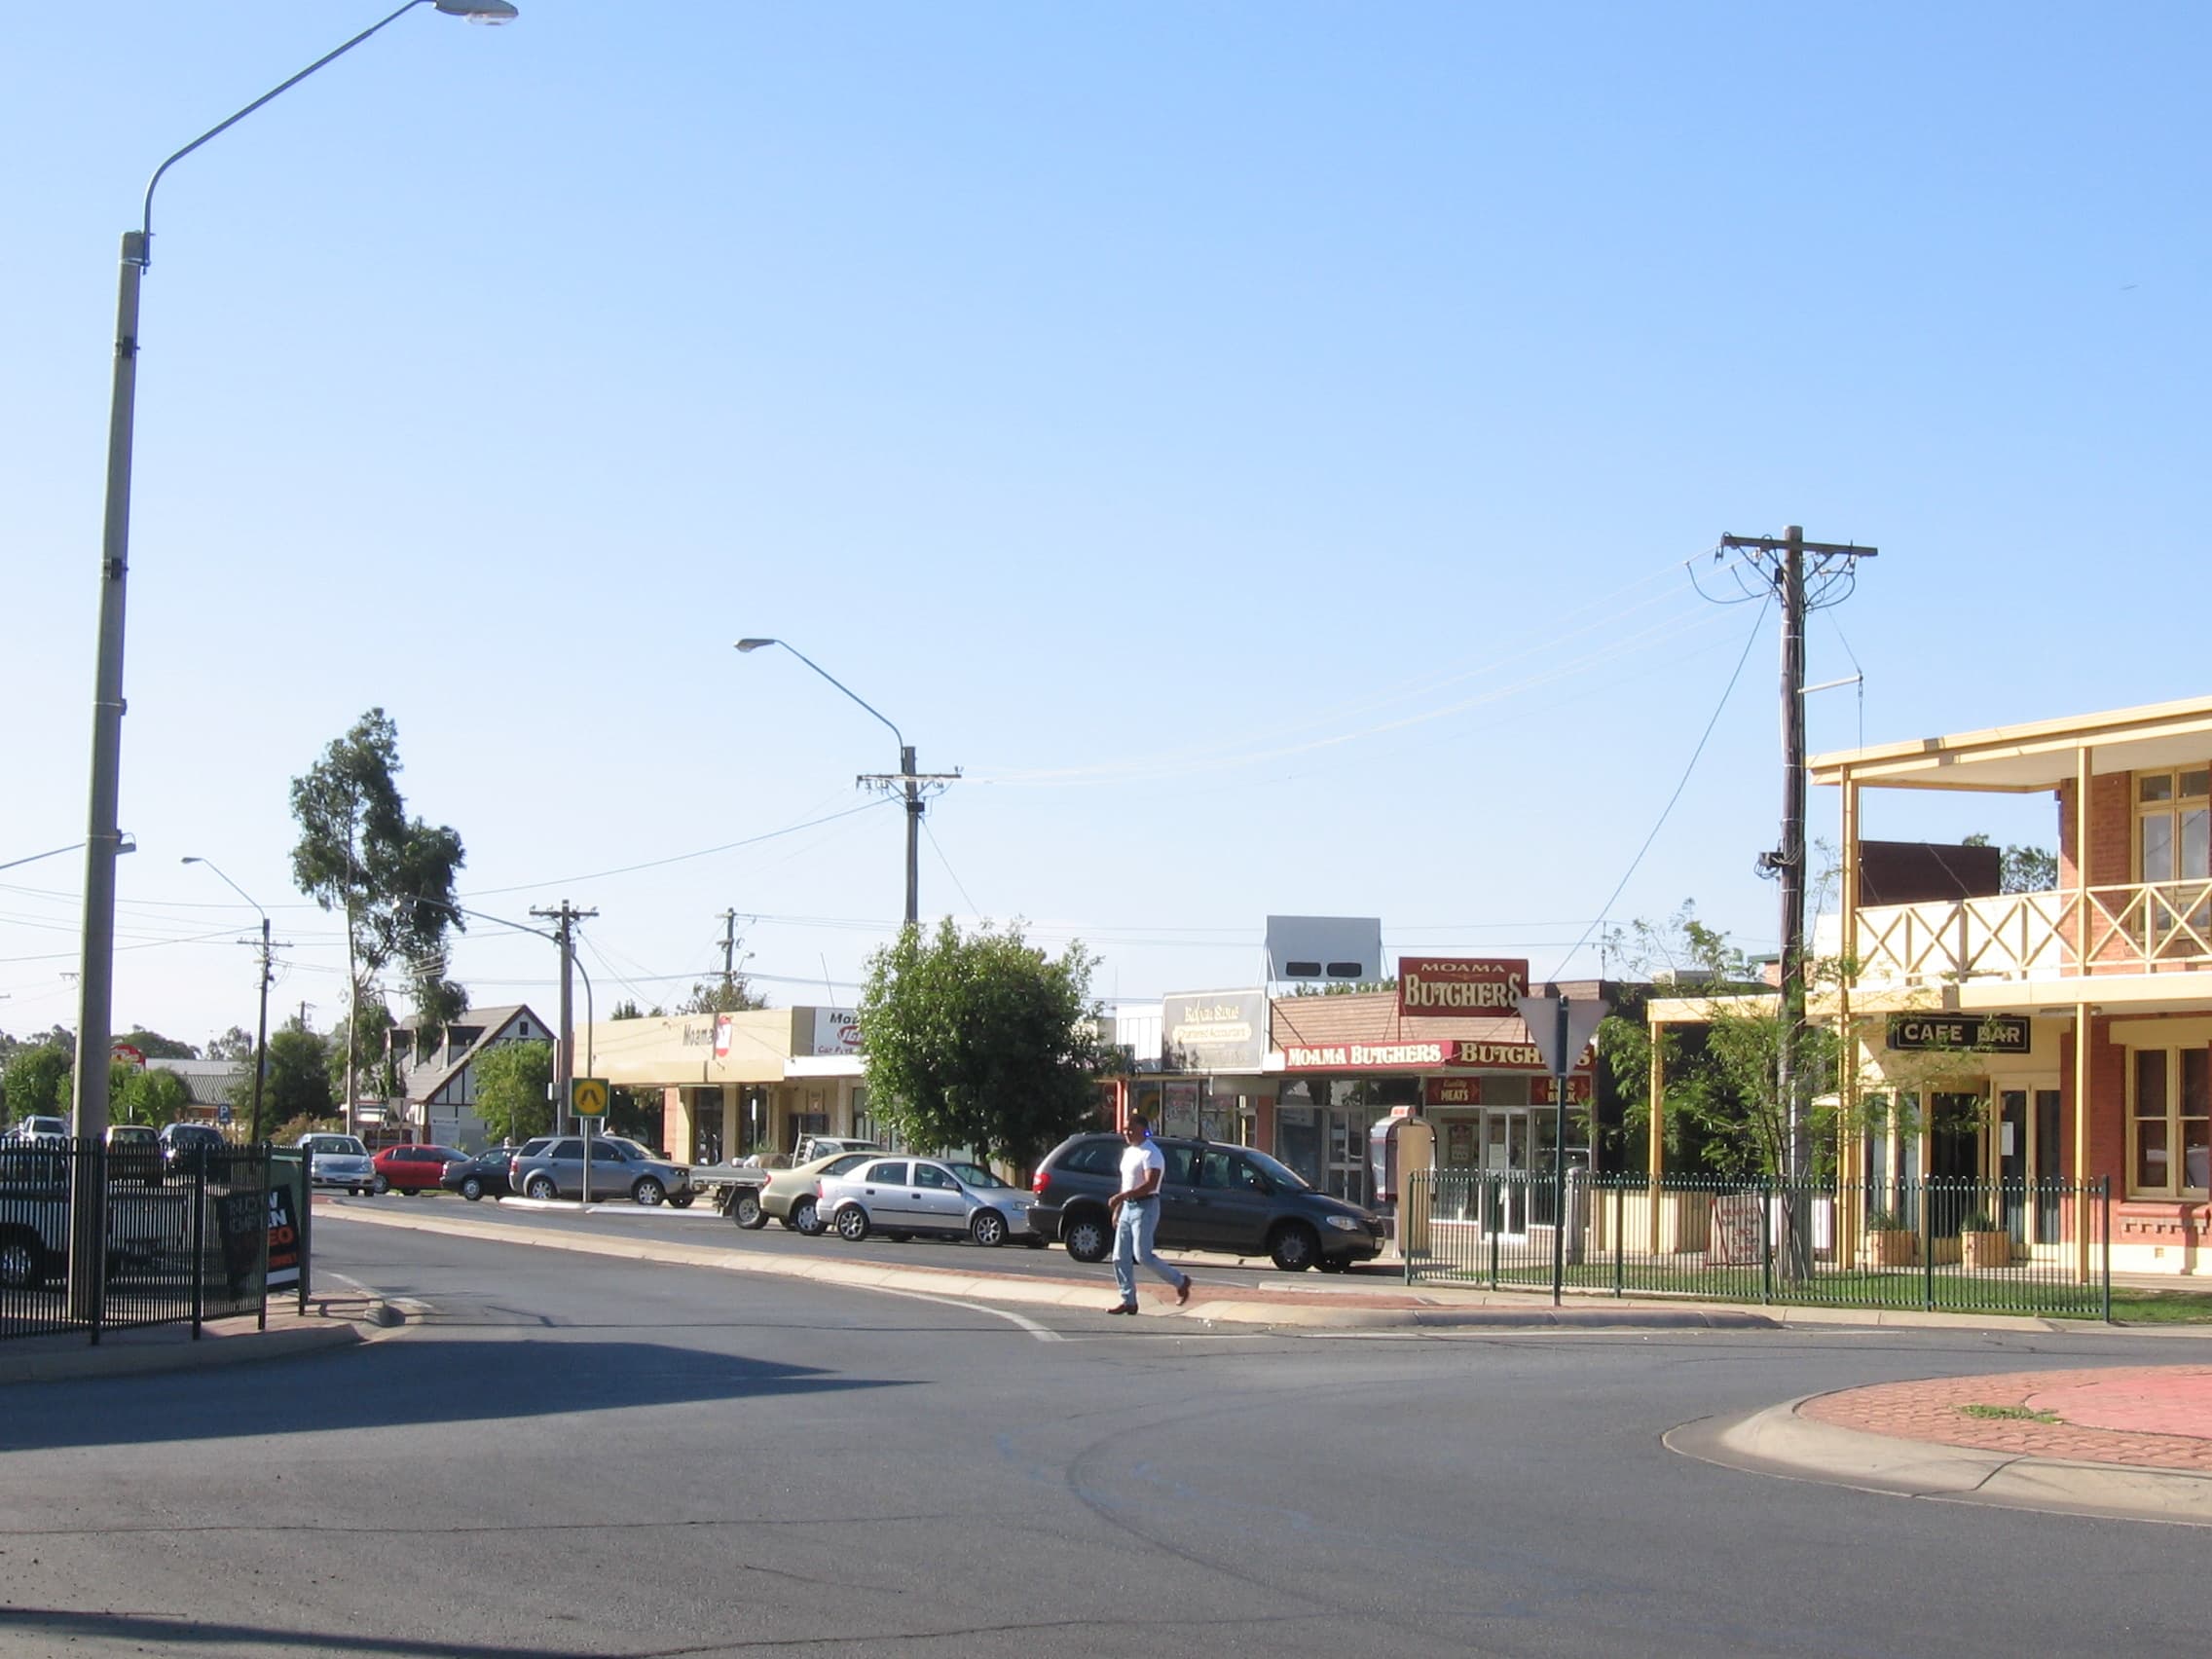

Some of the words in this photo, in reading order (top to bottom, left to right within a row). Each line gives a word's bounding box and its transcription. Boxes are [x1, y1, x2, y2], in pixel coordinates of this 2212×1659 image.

[1421, 963, 1505, 973] MOAMA
[1405, 973, 1523, 1008] BUTCHERS
[682, 1023, 715, 1047] Moama
[844, 1029, 865, 1042] IG
[1904, 1023, 1963, 1042] CAFE
[1977, 1025, 2020, 1043] BAR
[1287, 1048, 1347, 1066] MOAMA
[1350, 1044, 1442, 1064] BUTCHERS
[1460, 1043, 1591, 1066] BUTCHS
[1440, 1089, 1468, 1101] MEATS
[1548, 1089, 1576, 1102] BUK
[220, 1105, 229, 1118] P
